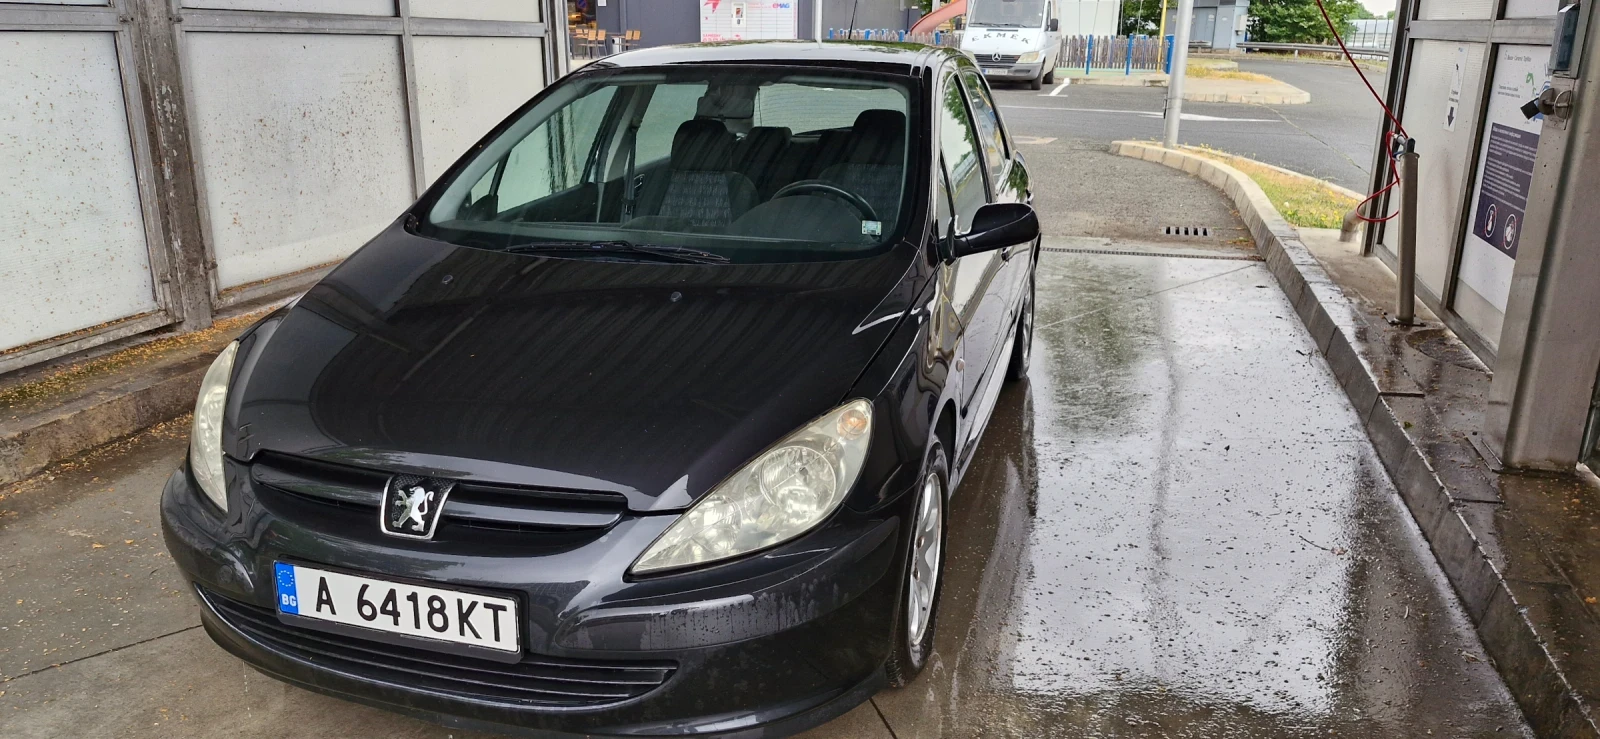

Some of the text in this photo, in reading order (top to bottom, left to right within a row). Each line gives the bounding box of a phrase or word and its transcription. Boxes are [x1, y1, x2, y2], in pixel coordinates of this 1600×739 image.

[971, 32, 1030, 44] EKMEK
[281, 593, 297, 607] BG
[315, 576, 337, 616] A
